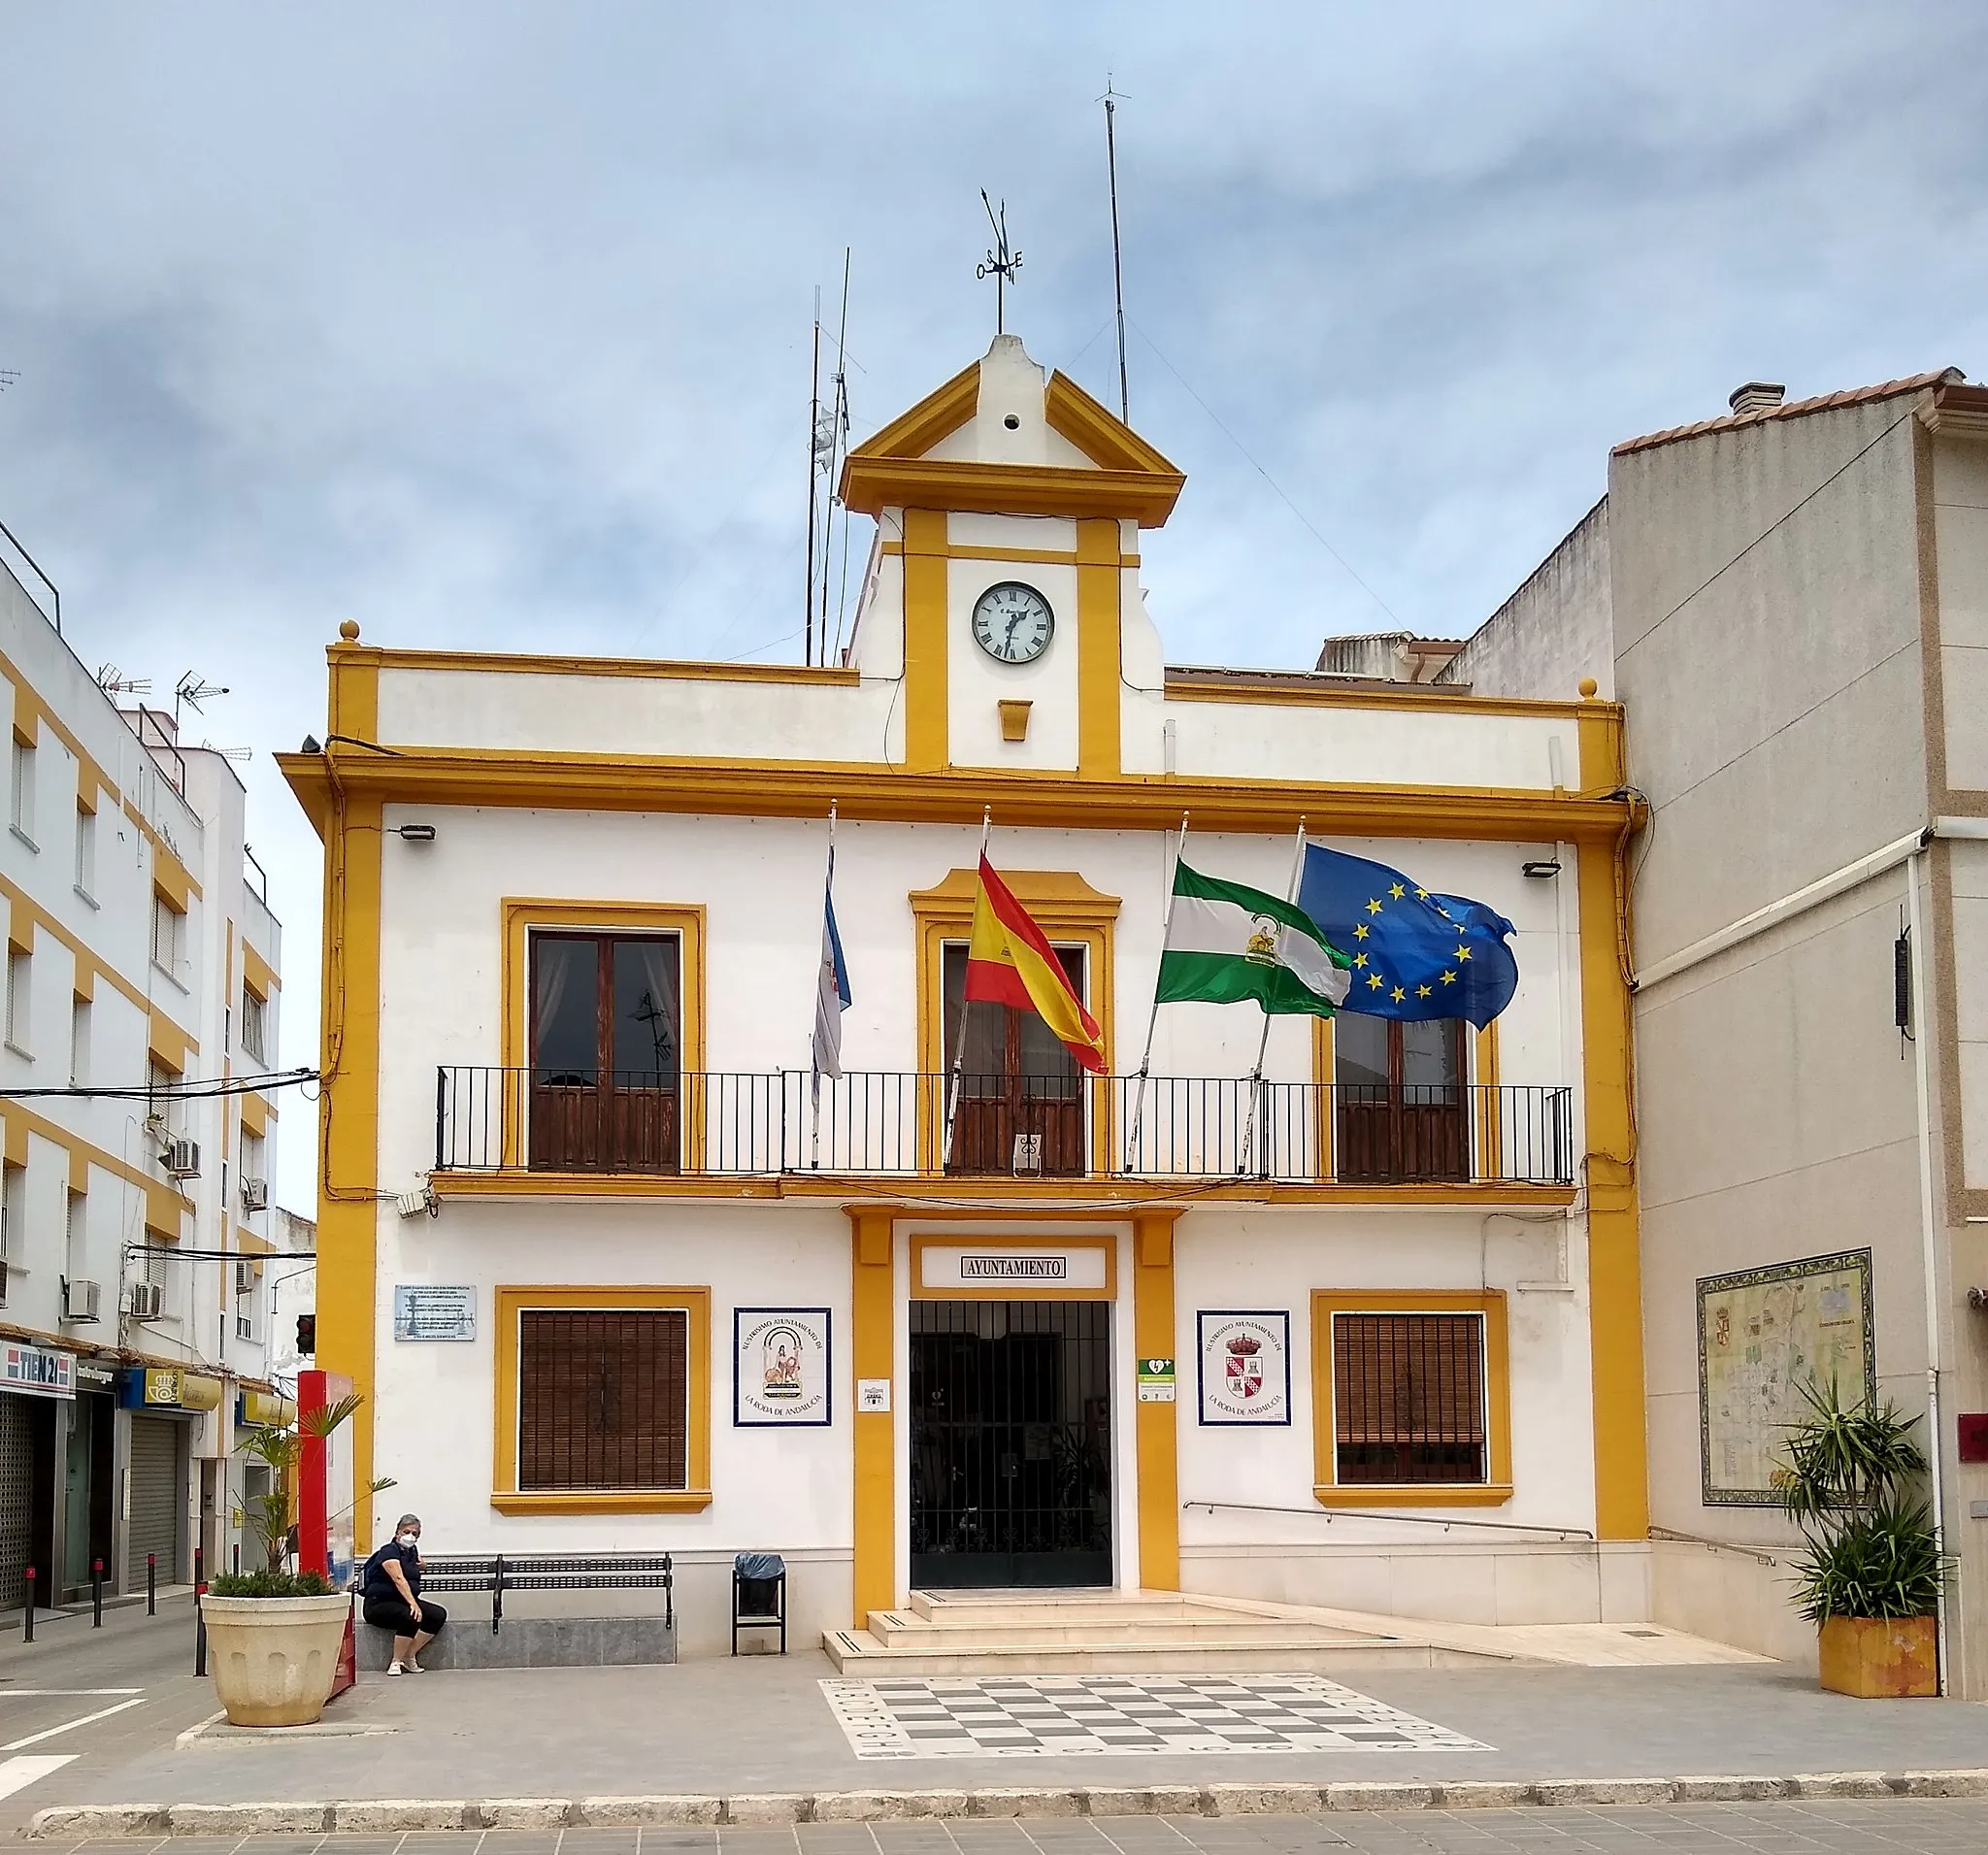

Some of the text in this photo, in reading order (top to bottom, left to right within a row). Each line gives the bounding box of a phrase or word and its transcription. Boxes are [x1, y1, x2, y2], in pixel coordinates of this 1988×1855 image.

[1014, 251, 1023, 268] E
[977, 263, 985, 280] O
[967, 1259, 1061, 1276] AYUNTAMIENTO
[773, 1318, 818, 1342] AYUNTAMIENTO
[815, 1341, 823, 1350] DE
[1235, 1320, 1277, 1343] AYUNTAMIENTO
[1274, 1342, 1282, 1351] DE
[746, 1394, 754, 1405] LA
[753, 1402, 773, 1414] RODA
[1209, 1394, 1217, 1405] LA
[1217, 1402, 1236, 1414] RODA
